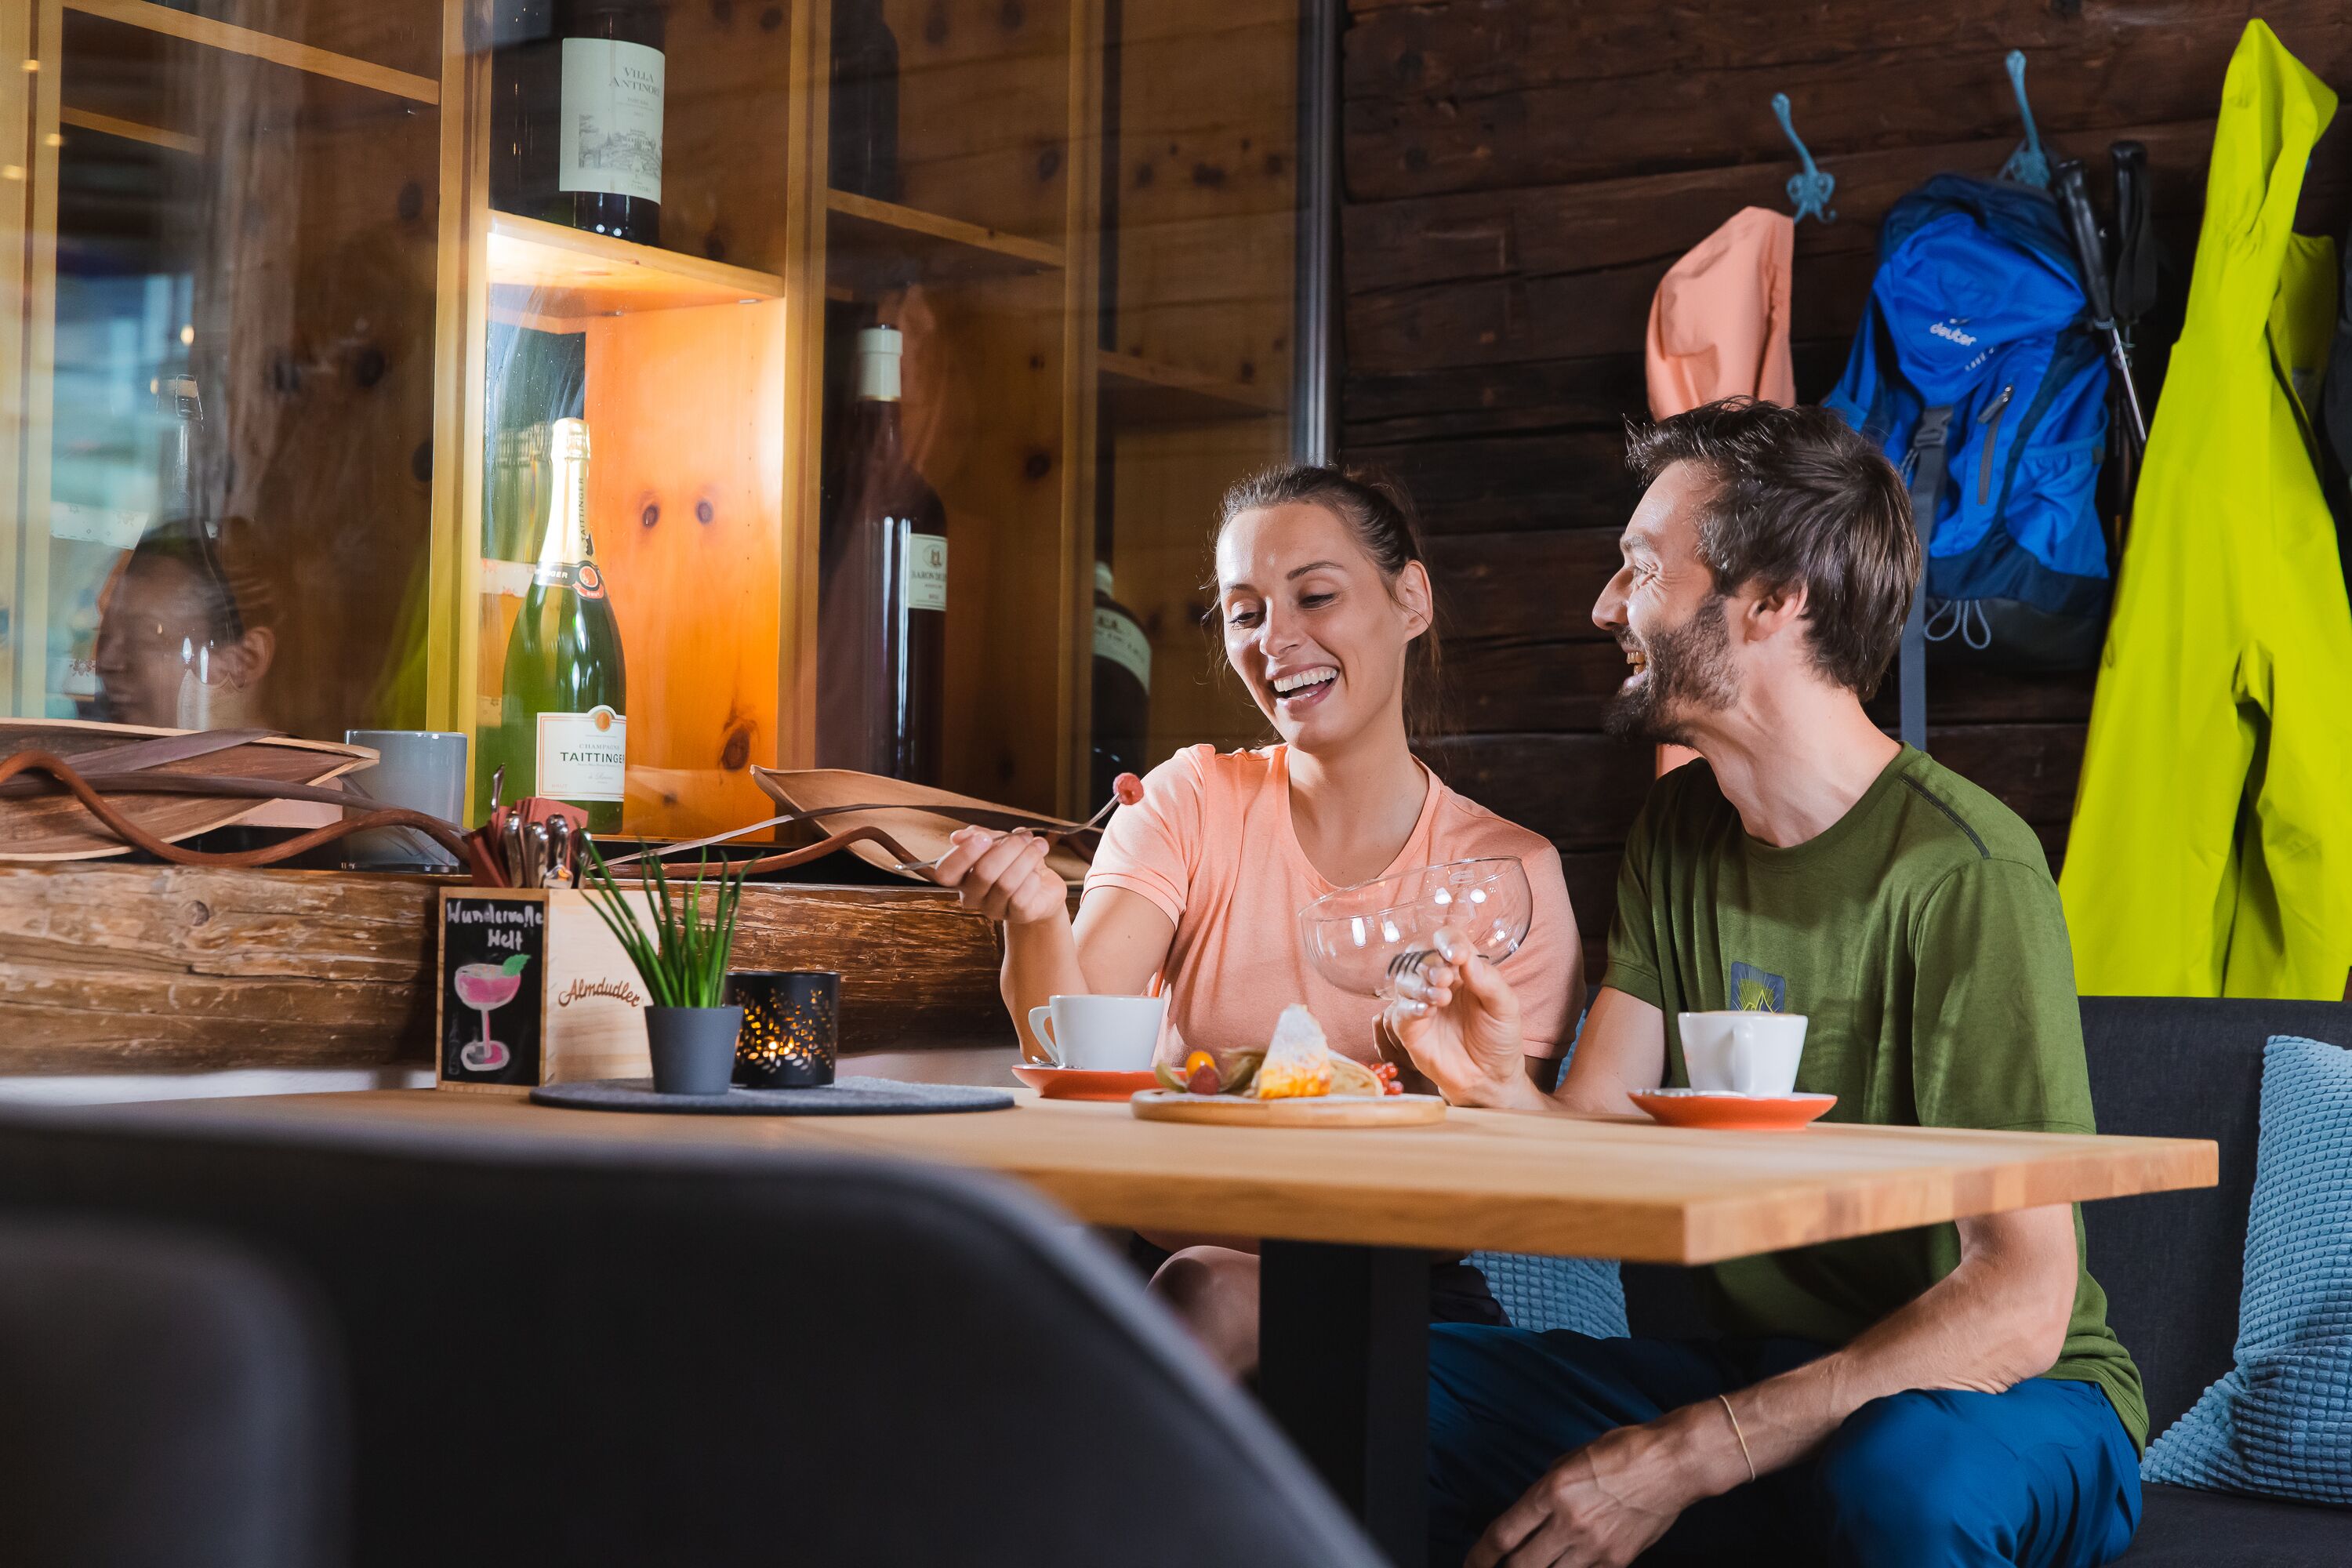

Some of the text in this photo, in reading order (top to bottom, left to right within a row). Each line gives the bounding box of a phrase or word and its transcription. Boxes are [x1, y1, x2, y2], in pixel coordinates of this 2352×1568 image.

[622, 67, 654, 83] VILLA
[1930, 322, 1976, 346] deuter
[578, 477, 587, 541] TAITTINGER
[487, 928, 523, 951] Welt
[558, 977, 640, 1007] Almdudler
